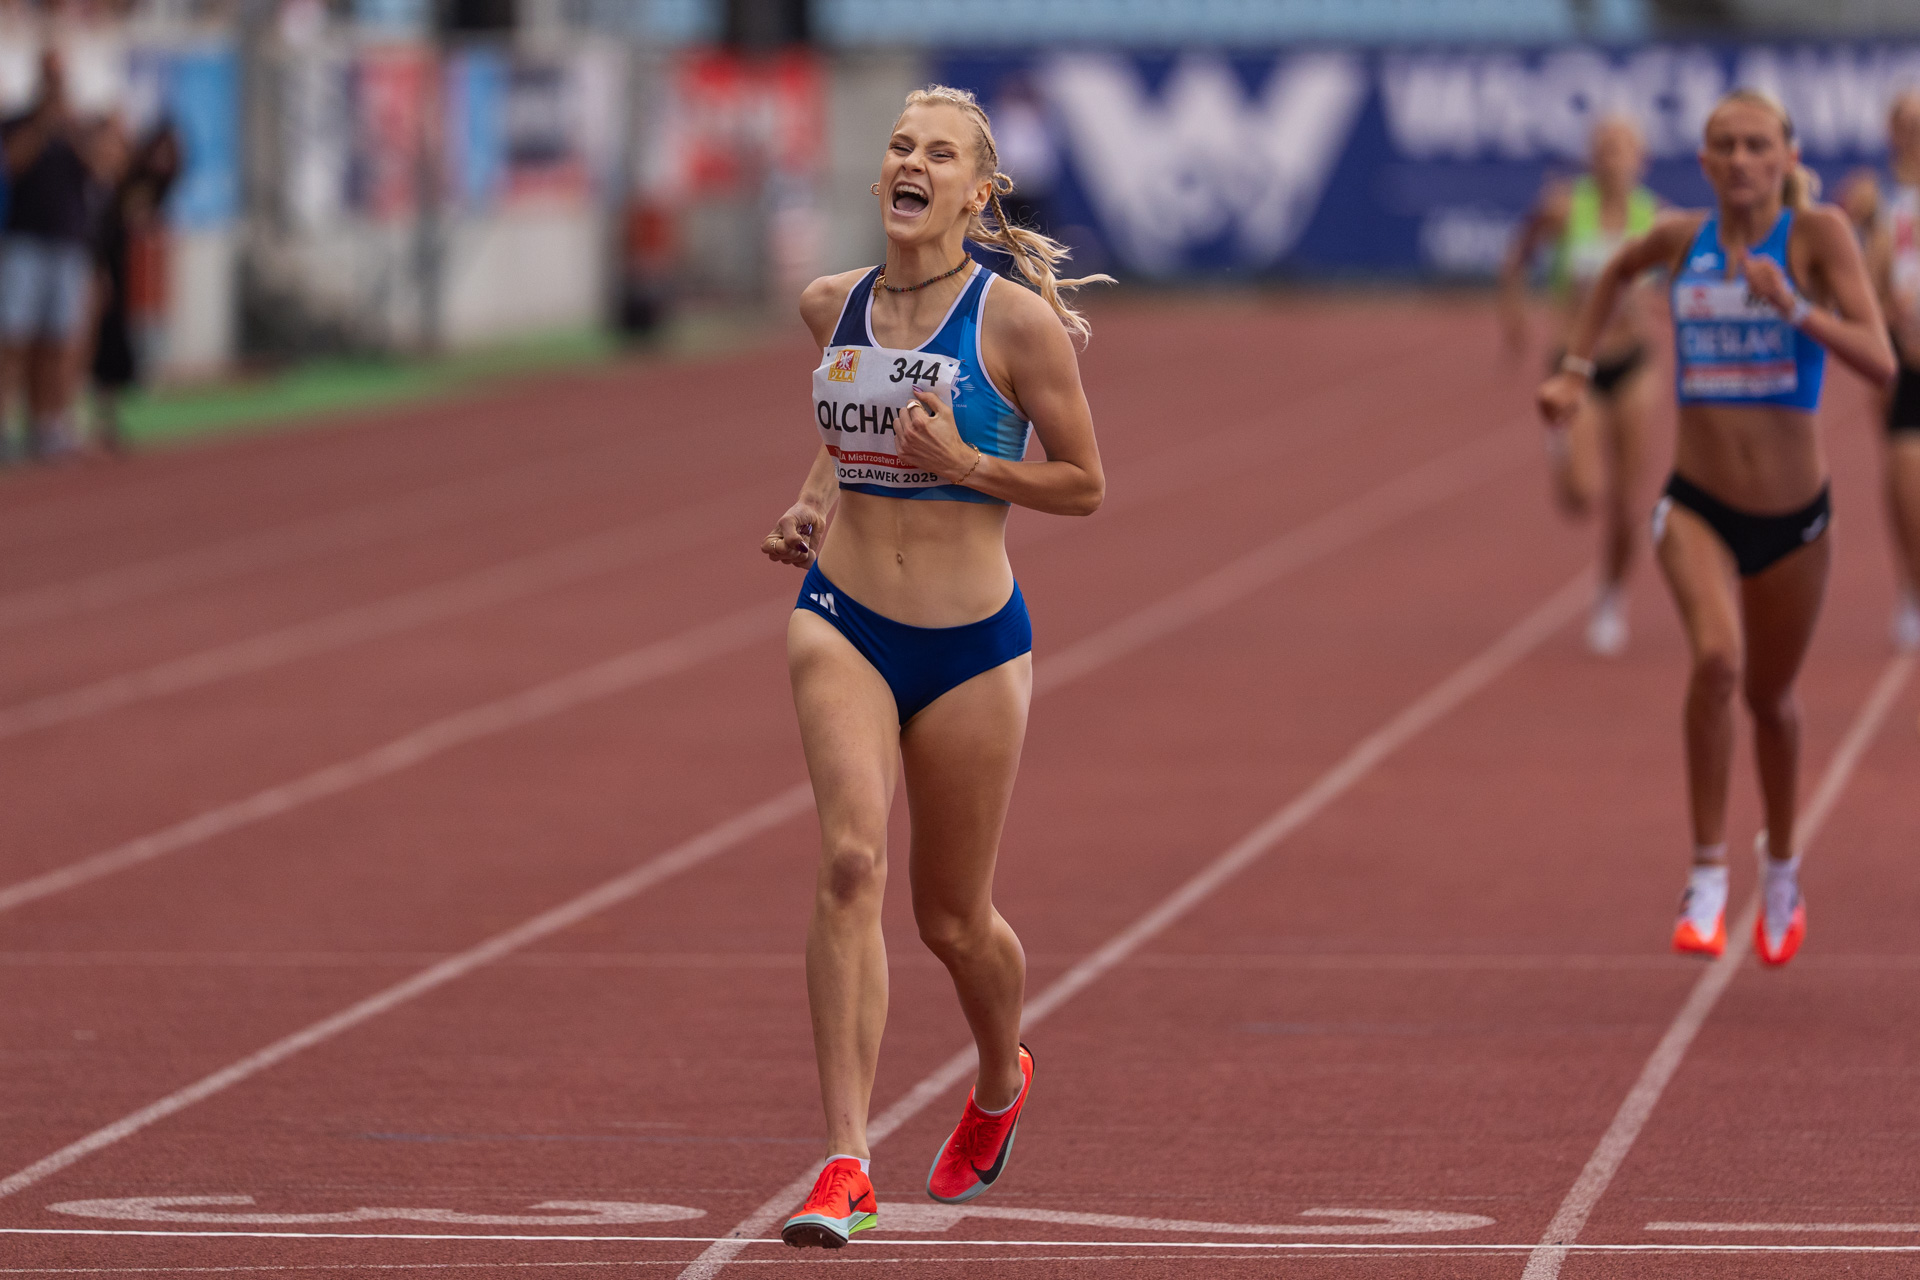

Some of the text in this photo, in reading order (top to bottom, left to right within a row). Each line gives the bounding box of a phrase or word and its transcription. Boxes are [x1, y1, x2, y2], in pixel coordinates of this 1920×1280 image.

[829, 369, 856, 381] PZLA
[889, 357, 941, 386] 344
[817, 400, 901, 436] OLCHA
[848, 453, 894, 465] Mistrzostwa
[903, 472, 938, 483] 2025
